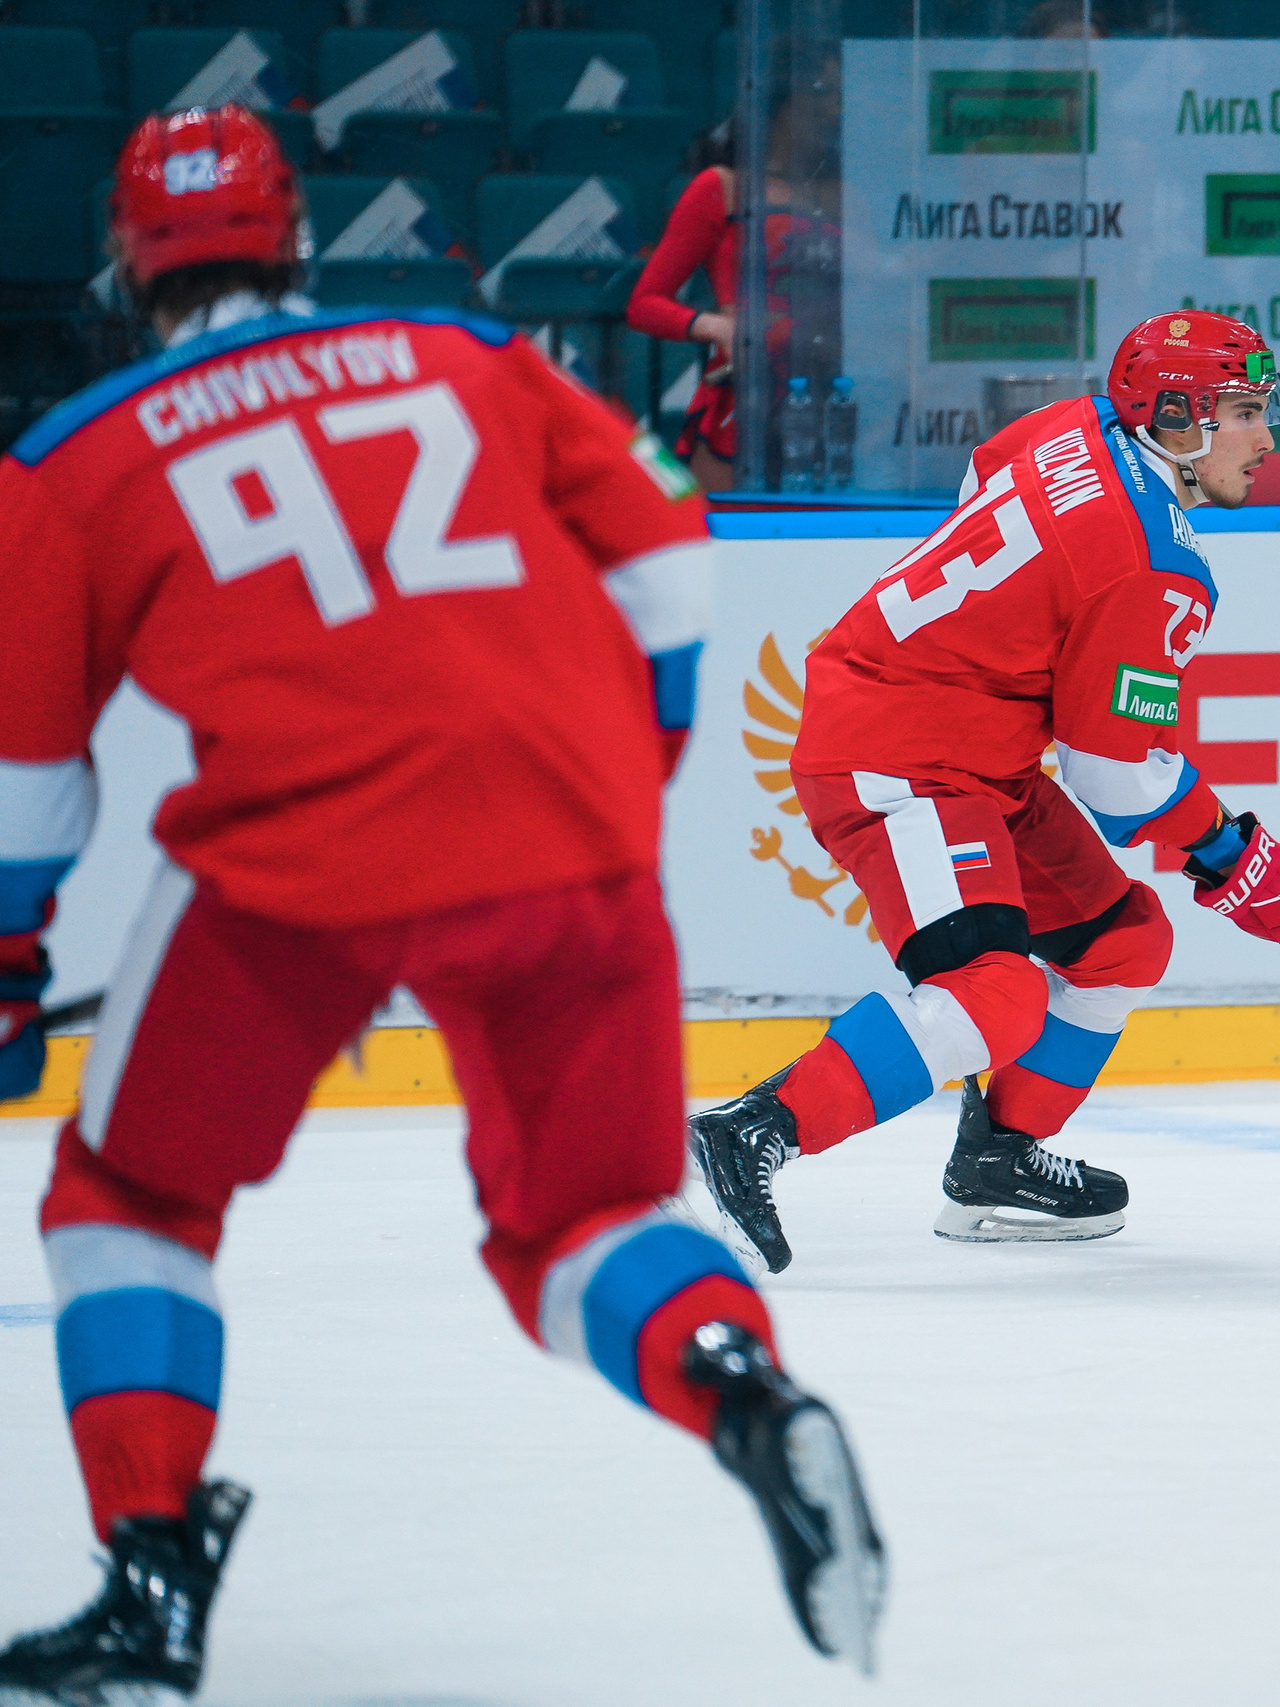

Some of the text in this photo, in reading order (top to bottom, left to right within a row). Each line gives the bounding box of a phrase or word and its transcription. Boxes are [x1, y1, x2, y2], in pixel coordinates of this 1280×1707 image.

[1158, 371, 1195, 382] CCM
[165, 382, 528, 628] 92
[1033, 427, 1105, 517] KUZMIN
[1162, 588, 1208, 669] 73
[1212, 831, 1276, 915] AUER
[1014, 1188, 1059, 1207] BAUER
